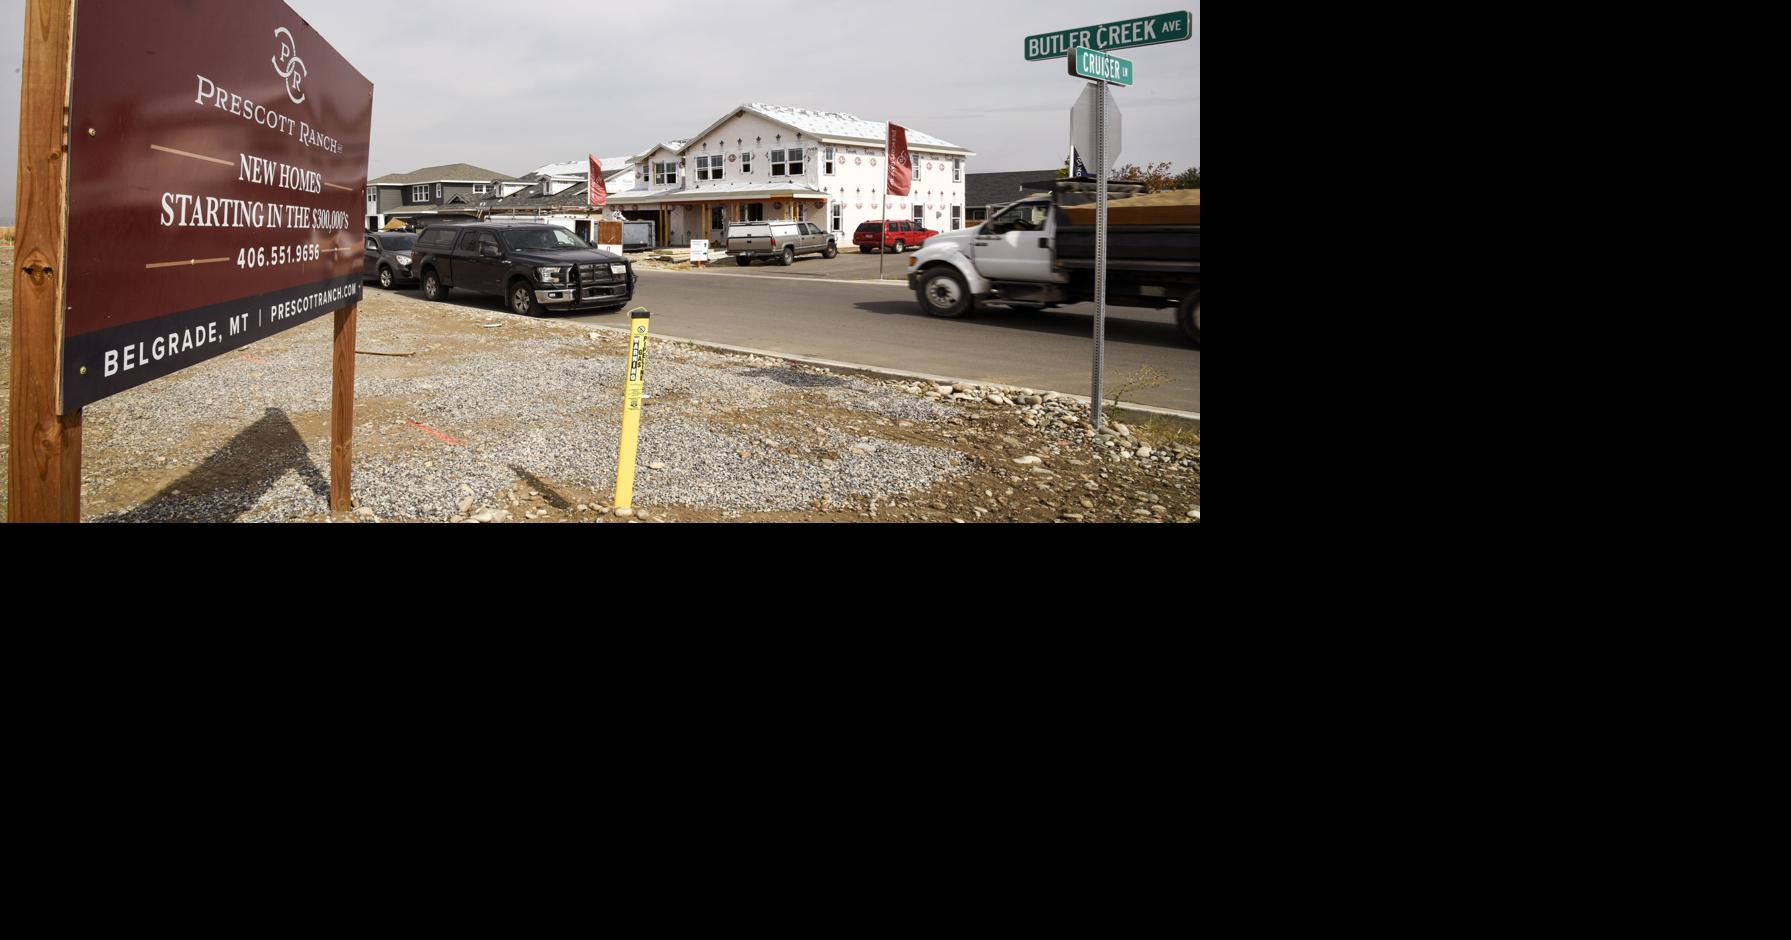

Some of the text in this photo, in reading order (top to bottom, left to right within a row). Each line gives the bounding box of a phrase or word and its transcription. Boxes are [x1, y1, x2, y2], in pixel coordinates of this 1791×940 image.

[1028, 19, 1182, 58] BUTLER CREEK AVE
[1082, 52, 1129, 80] CRUISER LN
[238, 153, 322, 195] NEW HOMES
[160, 192, 264, 227] STARTING
[266, 203, 283, 228] IN
[286, 205, 311, 229] THE
[236, 243, 320, 269] 406.551.9656
[103, 283, 357, 377] BELGRADE, MT PRESCOTTRANCH.COM
